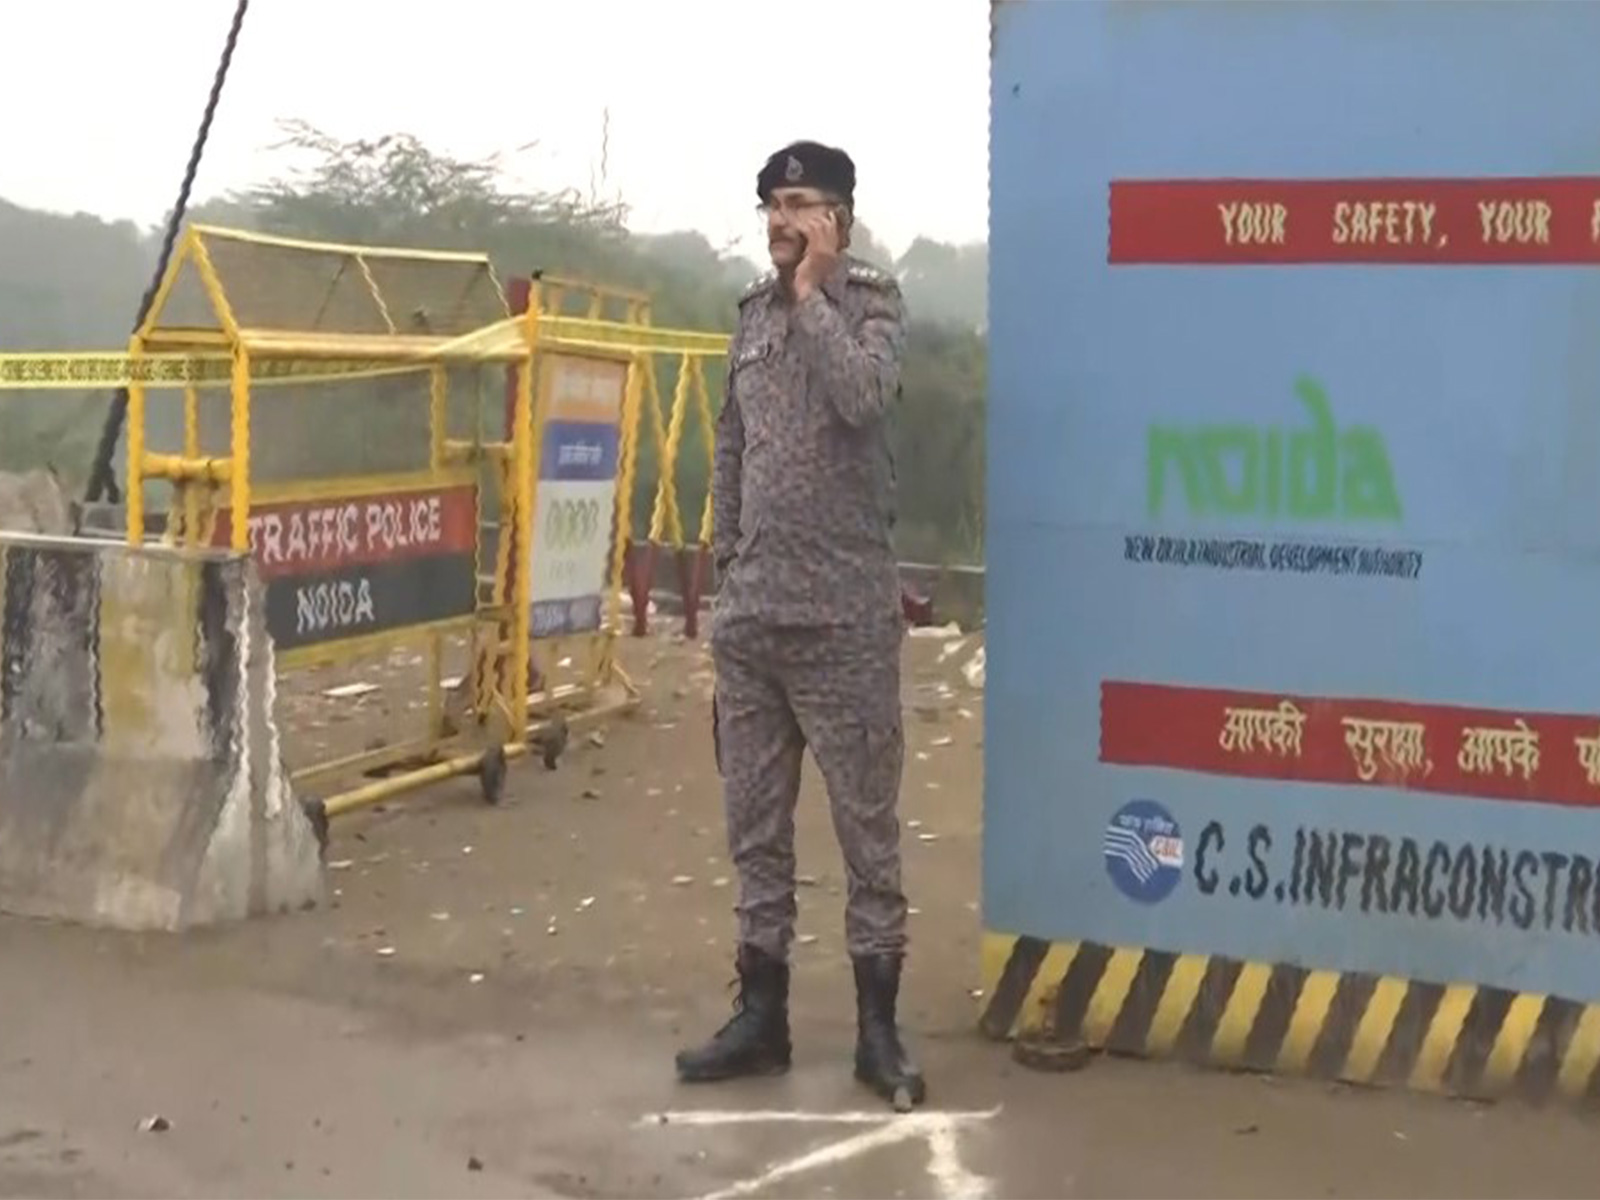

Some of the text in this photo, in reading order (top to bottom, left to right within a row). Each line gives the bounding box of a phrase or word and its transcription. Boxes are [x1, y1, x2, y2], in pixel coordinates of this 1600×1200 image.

[1218, 202, 1288, 245] YOUR
[1332, 201, 1448, 248] SAFETY,
[1479, 199, 1552, 245] YOUR
[245, 497, 442, 564] TRAFFIC POLICE
[1124, 535, 1155, 563] NEW
[296, 577, 375, 635] NOIDA
[1218, 700, 1308, 758] आपकी
[1341, 715, 1434, 781] सुरक्षा,
[1457, 718, 1541, 781] आपके
